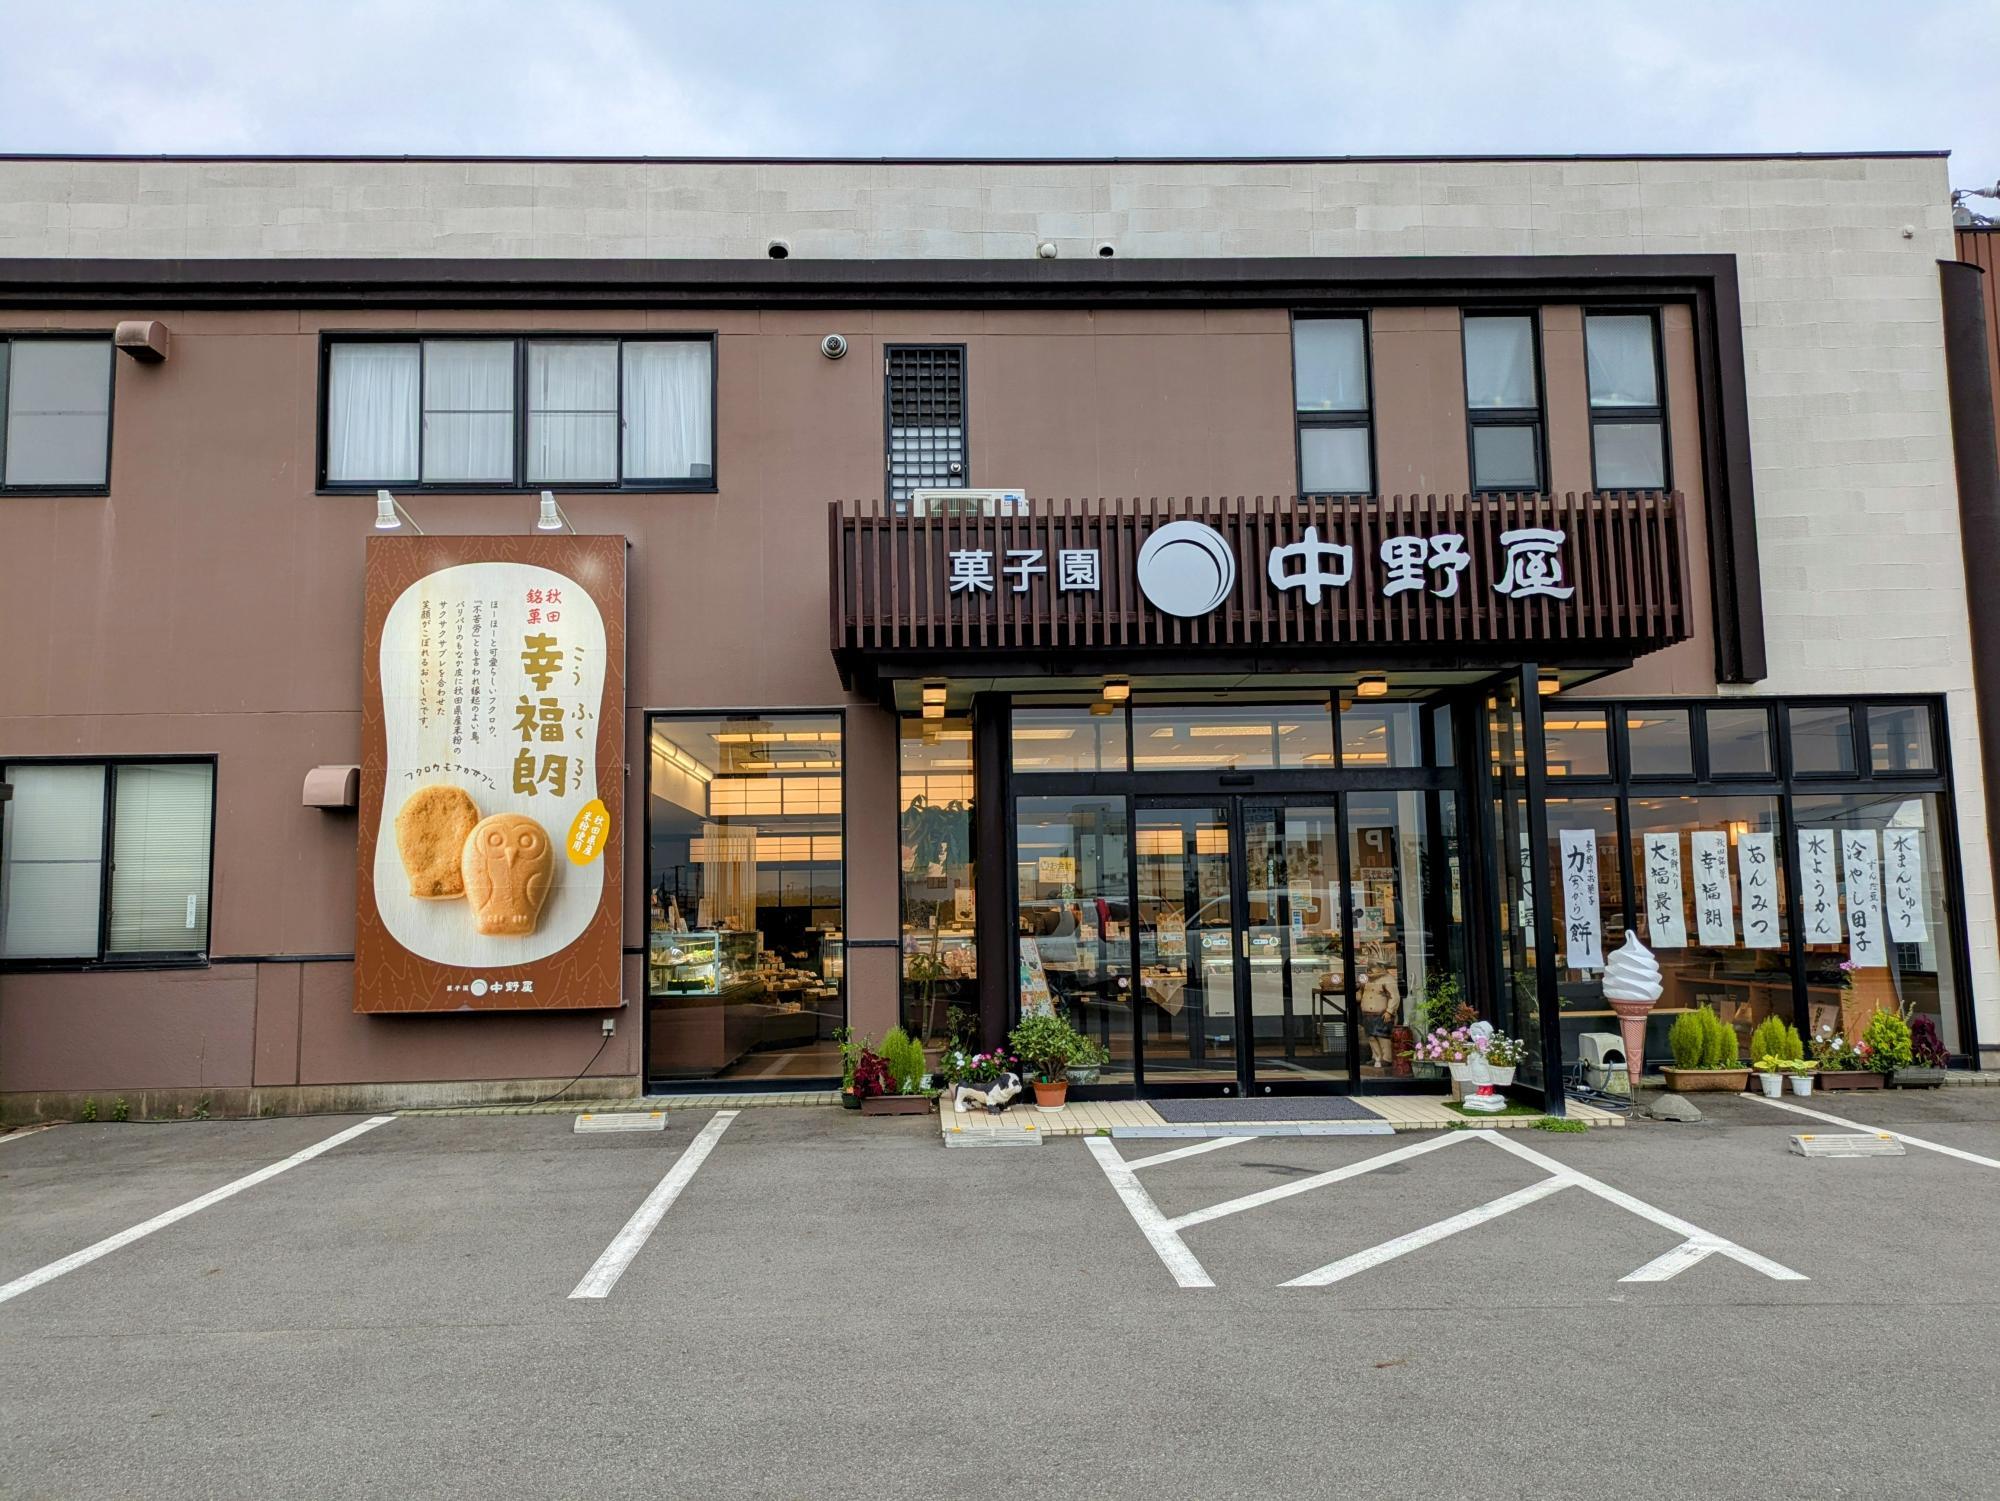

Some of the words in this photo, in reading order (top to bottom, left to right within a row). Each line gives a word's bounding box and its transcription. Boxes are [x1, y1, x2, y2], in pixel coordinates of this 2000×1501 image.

[948, 548, 1101, 594] 菓子園
[1268, 525, 1576, 606] 中野屋
[526, 588, 543, 625] 銘菓
[545, 588, 562, 623] 秋田
[572, 646, 585, 686] こう
[511, 633, 569, 798] 幸福朗
[571, 702, 593, 740] ふく
[582, 814, 605, 857] 秋田県産
[1650, 840, 1672, 935] 大福最中
[1700, 849, 1723, 928] 幸福朗
[1747, 844, 1769, 933] あんみつ
[1808, 835, 1831, 934] 水ようかん
[1846, 839, 1872, 952] 冷やし団子
[1892, 835, 1916, 928] 水まんじゅう
[489, 980, 534, 994] 中野屋
